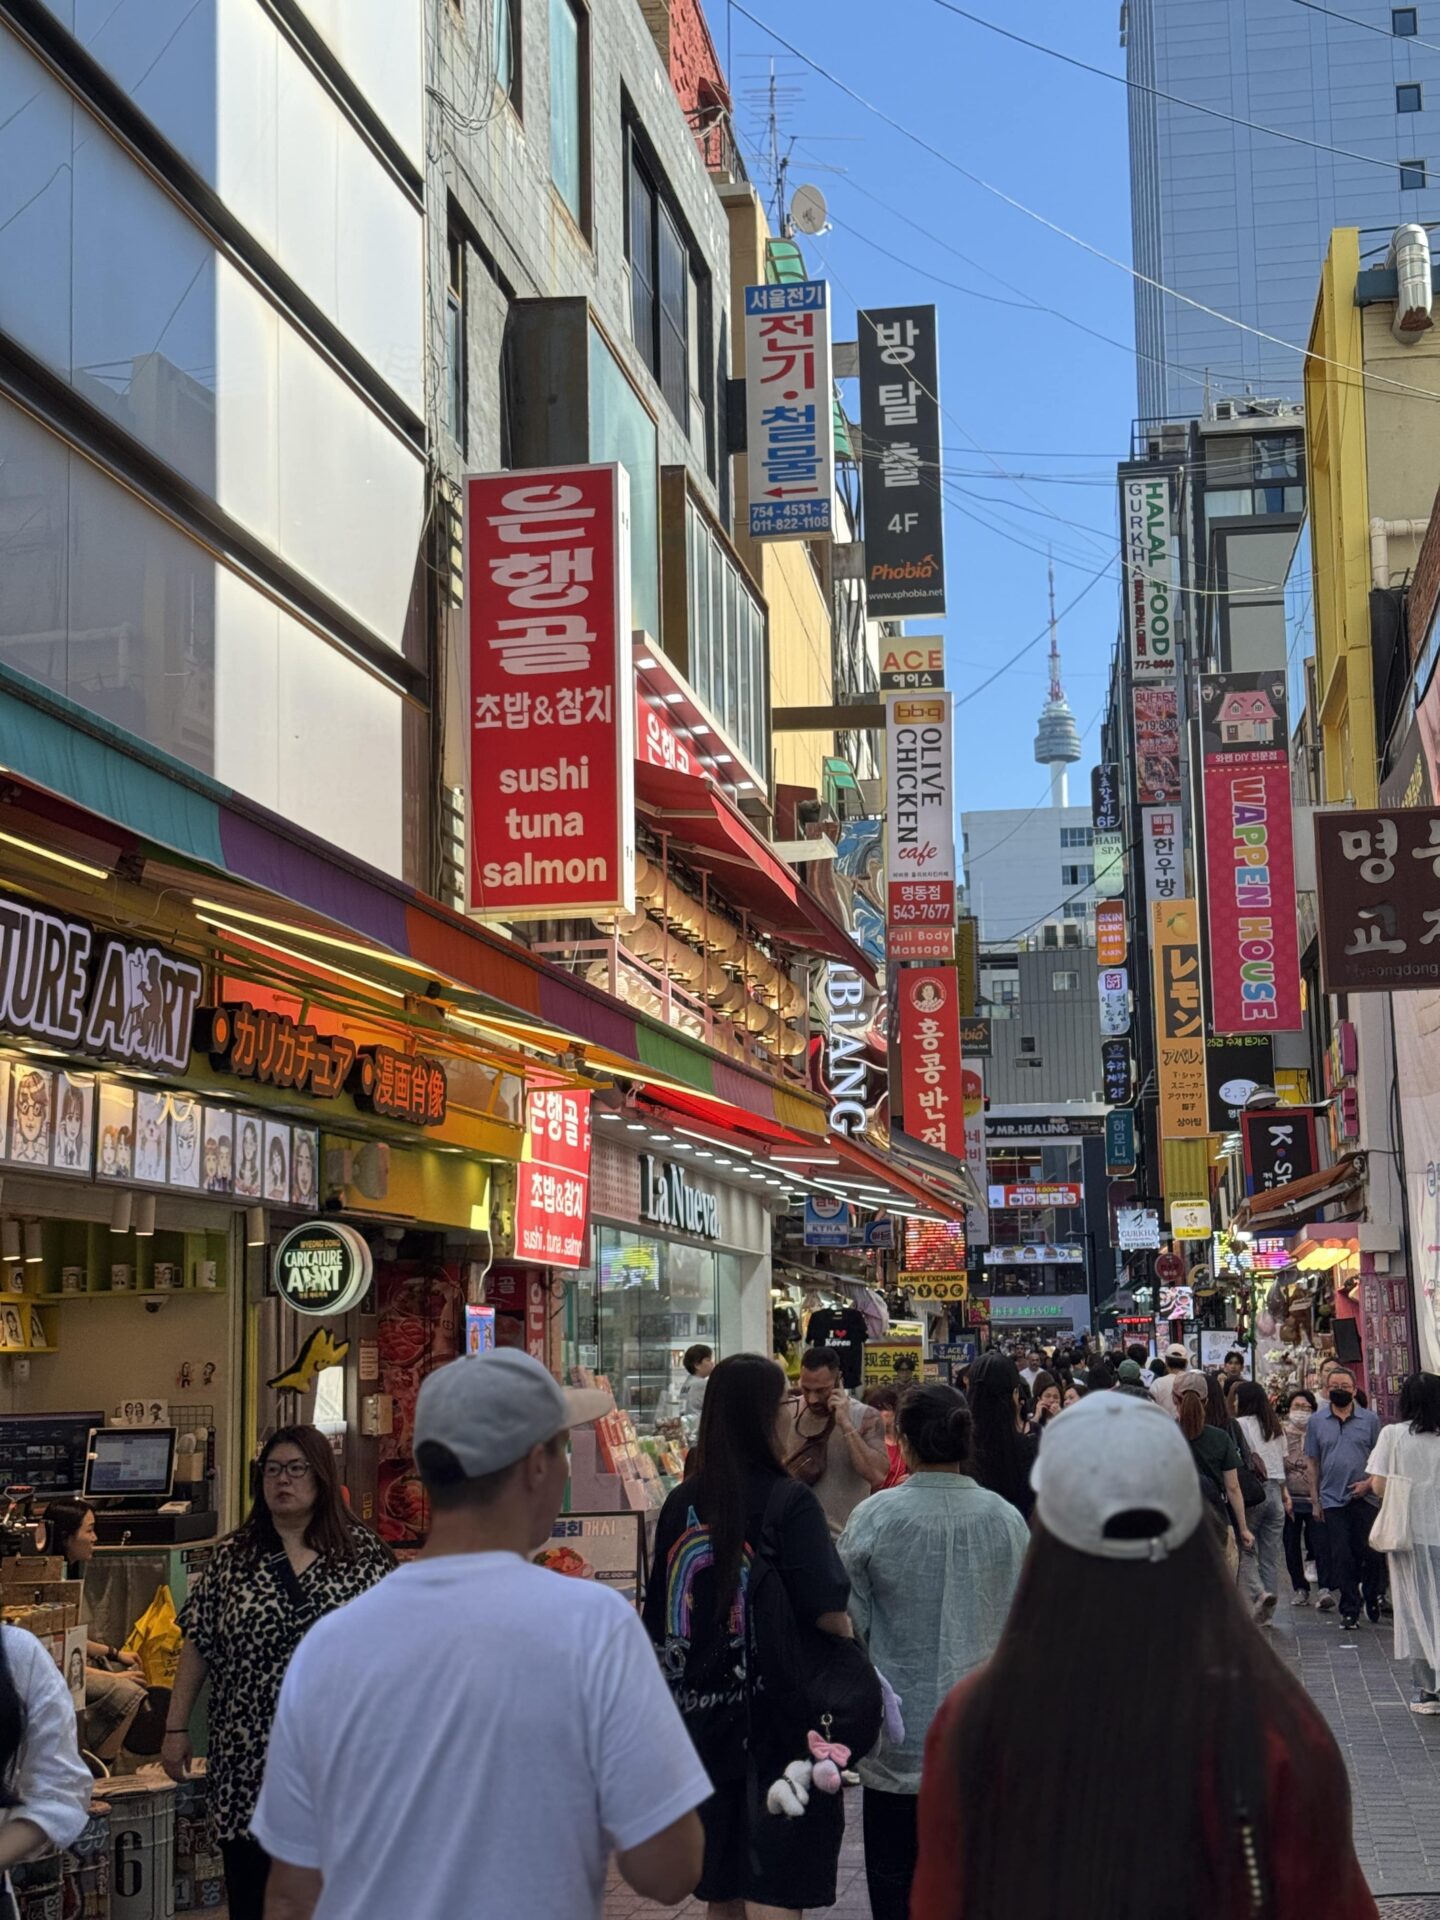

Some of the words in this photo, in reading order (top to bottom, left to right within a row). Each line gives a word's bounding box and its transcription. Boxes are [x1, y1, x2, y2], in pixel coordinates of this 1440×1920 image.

[750, 285, 824, 310] 서울전기
[876, 319, 921, 489] 방탈출
[751, 516, 830, 532] 011-822-1108
[887, 512, 920, 534] 4F
[1128, 482, 1146, 579] GURKHA
[1144, 481, 1167, 568] HALAL
[485, 483, 600, 676] 은행골
[870, 558, 934, 582] Phobia
[868, 586, 944, 601] www.xphobia.net
[1150, 579, 1171, 657] FOOD
[882, 650, 943, 672] ACE
[892, 672, 933, 688] 에이스
[474, 685, 613, 731] 초밥&참치
[920, 727, 946, 807] OLIVE
[1235, 752, 1250, 763] DIY
[498, 754, 591, 795] sushi
[896, 728, 919, 844] CHICKEN
[505, 807, 584, 841] tuna
[1097, 816, 1116, 828] 6F
[1095, 836, 1121, 845] HAIR
[1101, 847, 1122, 856] SPA
[1230, 775, 1273, 908] WAPPEN
[897, 840, 939, 867] cafe
[483, 852, 607, 889] salmon
[1152, 837, 1178, 898] 한우방
[901, 884, 941, 901] 명동점
[893, 903, 951, 920] 543-7677
[1098, 912, 1123, 923] SKIN
[889, 930, 913, 942] Full
[918, 929, 950, 942] Body
[891, 944, 950, 956] Massage
[1238, 916, 1279, 1022] HOUSE
[1169, 948, 1202, 1038] レモン
[234, 1010, 354, 1092] カリカチュア
[375, 1050, 446, 1121] 漫画肖像
[912, 1017, 951, 1153] 홍콩반점
[1110, 1087, 1126, 1099] 2F
[530, 1091, 579, 1148] 은행골
[996, 1122, 1070, 1136] MR.HEALING
[1112, 1119, 1127, 1159] 하모니
[529, 1172, 583, 1220] 초밥&참치
[646, 1154, 668, 1225] La
[1121, 1229, 1157, 1239] GURKHA
[284, 1249, 343, 1268] CARICATURE
[927, 1274, 966, 1283] EXCHANGE
[824, 1337, 851, 1347] Korea
[828, 1330, 834, 1338] I
